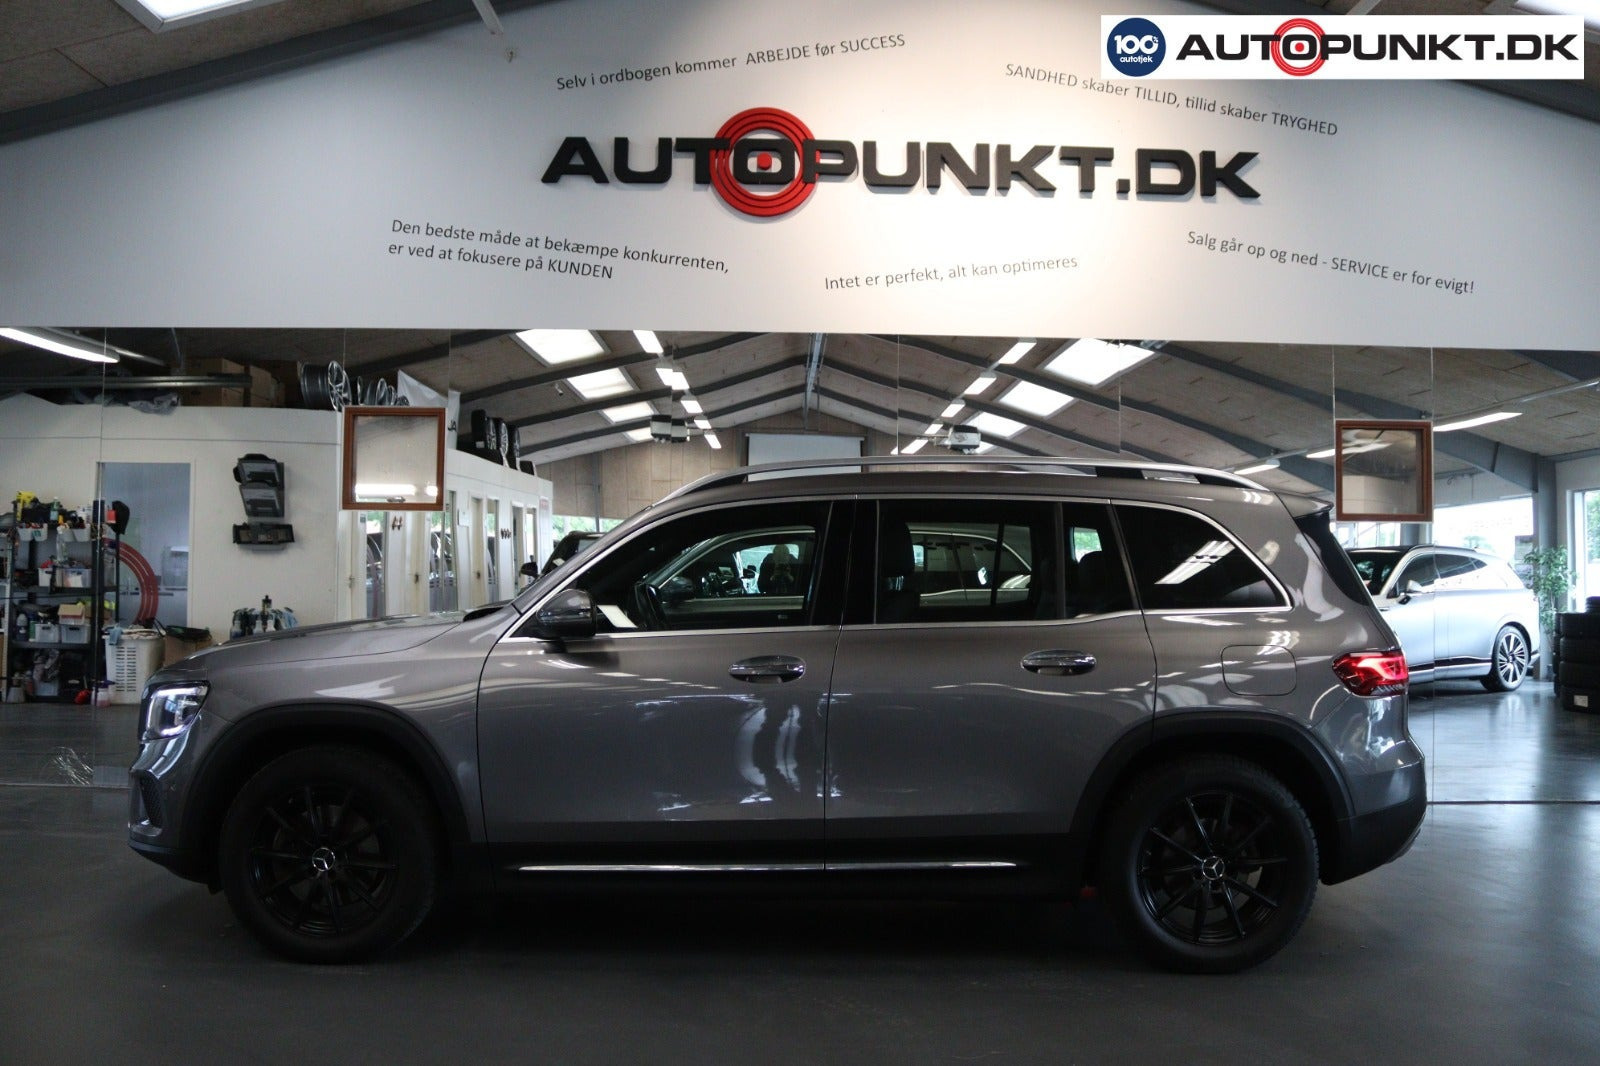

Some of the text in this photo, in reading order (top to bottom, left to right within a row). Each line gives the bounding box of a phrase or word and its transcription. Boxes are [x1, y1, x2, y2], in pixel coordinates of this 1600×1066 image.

[556, 33, 906, 90] Selv i ordbogen kommer ARBEJDE før SUCCESS
[1005, 63, 1339, 137] SANDHED skaber TILLID, tillid skaber TRYGHED
[541, 136, 1261, 199] AUTOPUNKT.DK
[387, 243, 613, 280] er ved at fokusere på KUNDEN
[391, 219, 729, 275] Den bedste måde at bekæmpe konkurrenten,
[824, 256, 1078, 291] Intet er perfekt, alt kan optimeres
[1187, 230, 1217, 252] Salg
[1219, 236, 1245, 254] går
[1246, 244, 1266, 260] op
[1269, 248, 1288, 264] og
[1290, 251, 1319, 267] ned
[1330, 256, 1389, 280] SERVICE
[1392, 270, 1408, 283] er
[1411, 269, 1432, 286] for
[1434, 277, 1475, 296] evigt!
